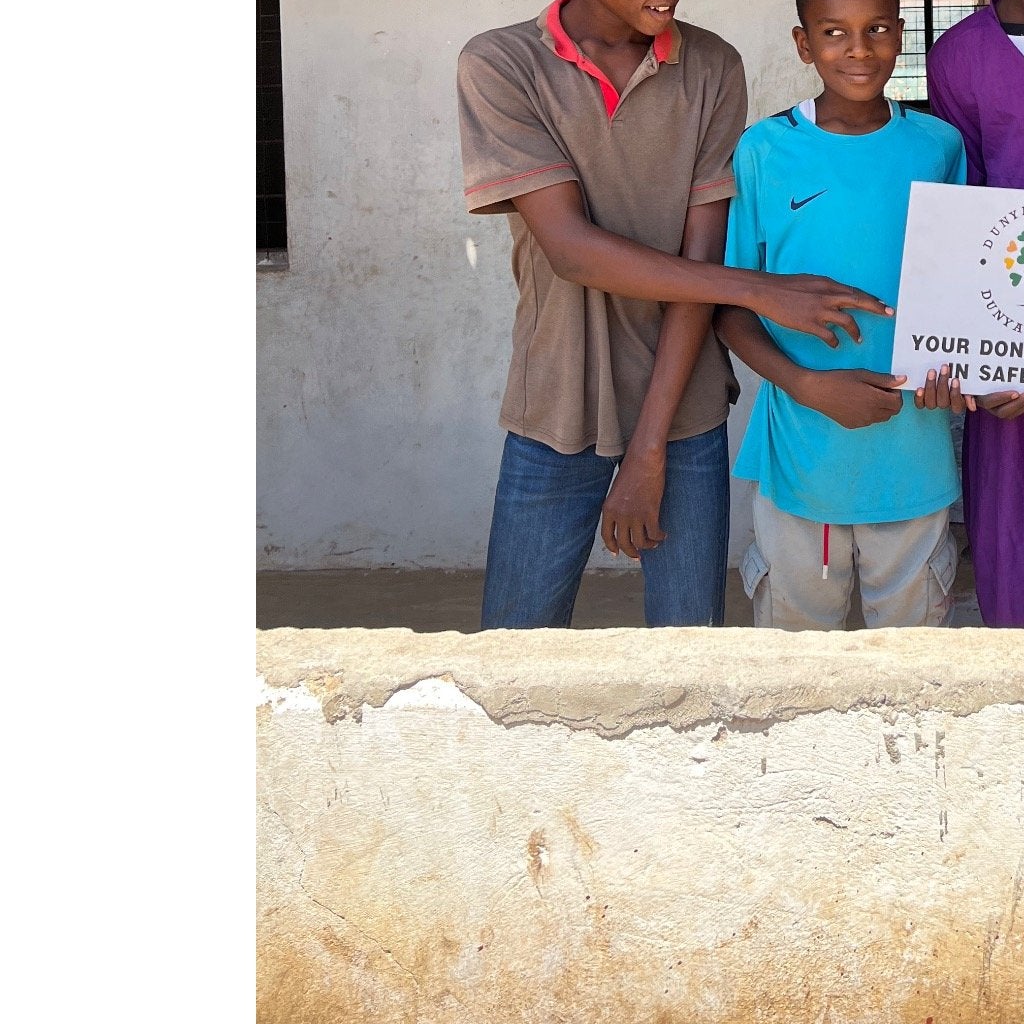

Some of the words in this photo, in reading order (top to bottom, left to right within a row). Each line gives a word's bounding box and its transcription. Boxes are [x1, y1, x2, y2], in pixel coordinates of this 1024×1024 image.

[981, 289, 1023, 334] DUNYA
[911, 334, 970, 355] YOUR
[948, 362, 969, 380] IN
